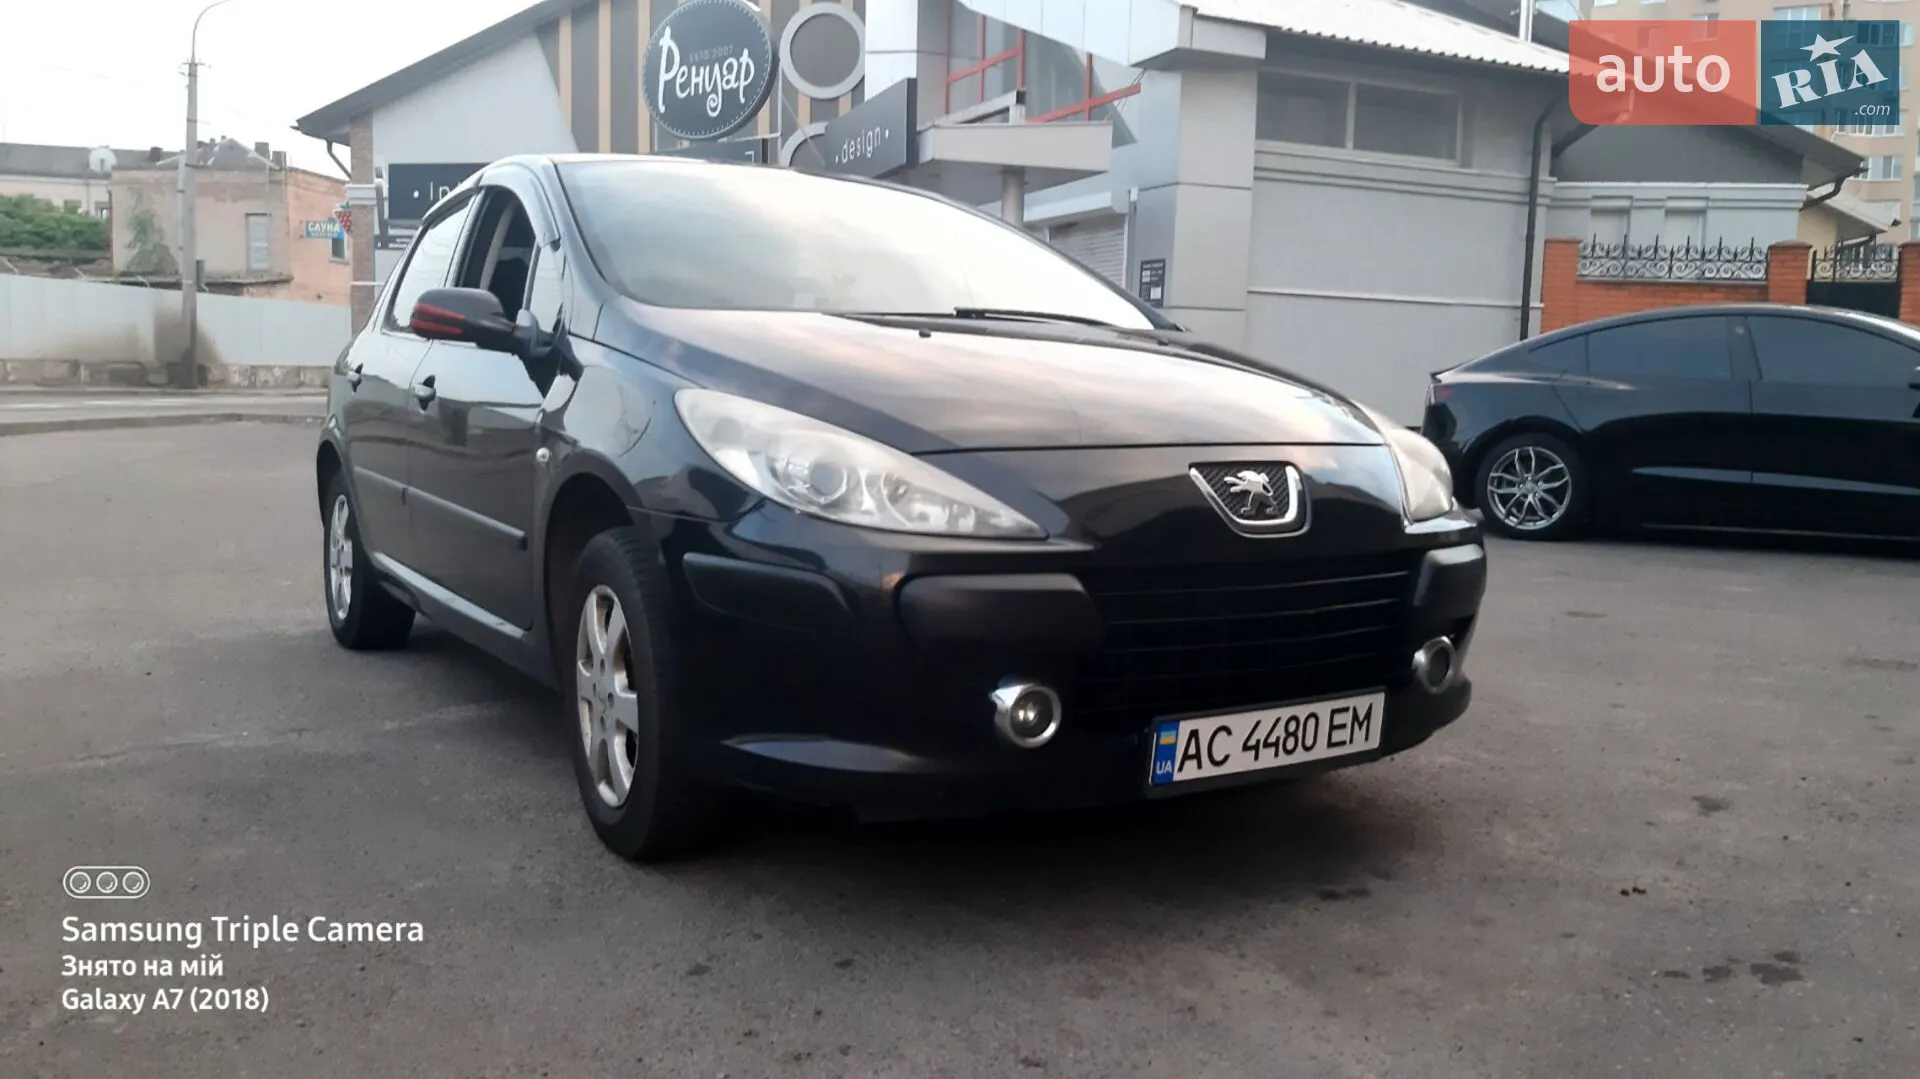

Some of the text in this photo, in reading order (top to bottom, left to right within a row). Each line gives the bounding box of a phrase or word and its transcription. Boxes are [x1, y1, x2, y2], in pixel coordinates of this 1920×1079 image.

[657, 26, 755, 118] Ренуар
[841, 126, 882, 164] design
[308, 222, 340, 233] САУНА
[1177, 702, 1374, 773] AC 4480 EM
[1156, 759, 1173, 775] UA
